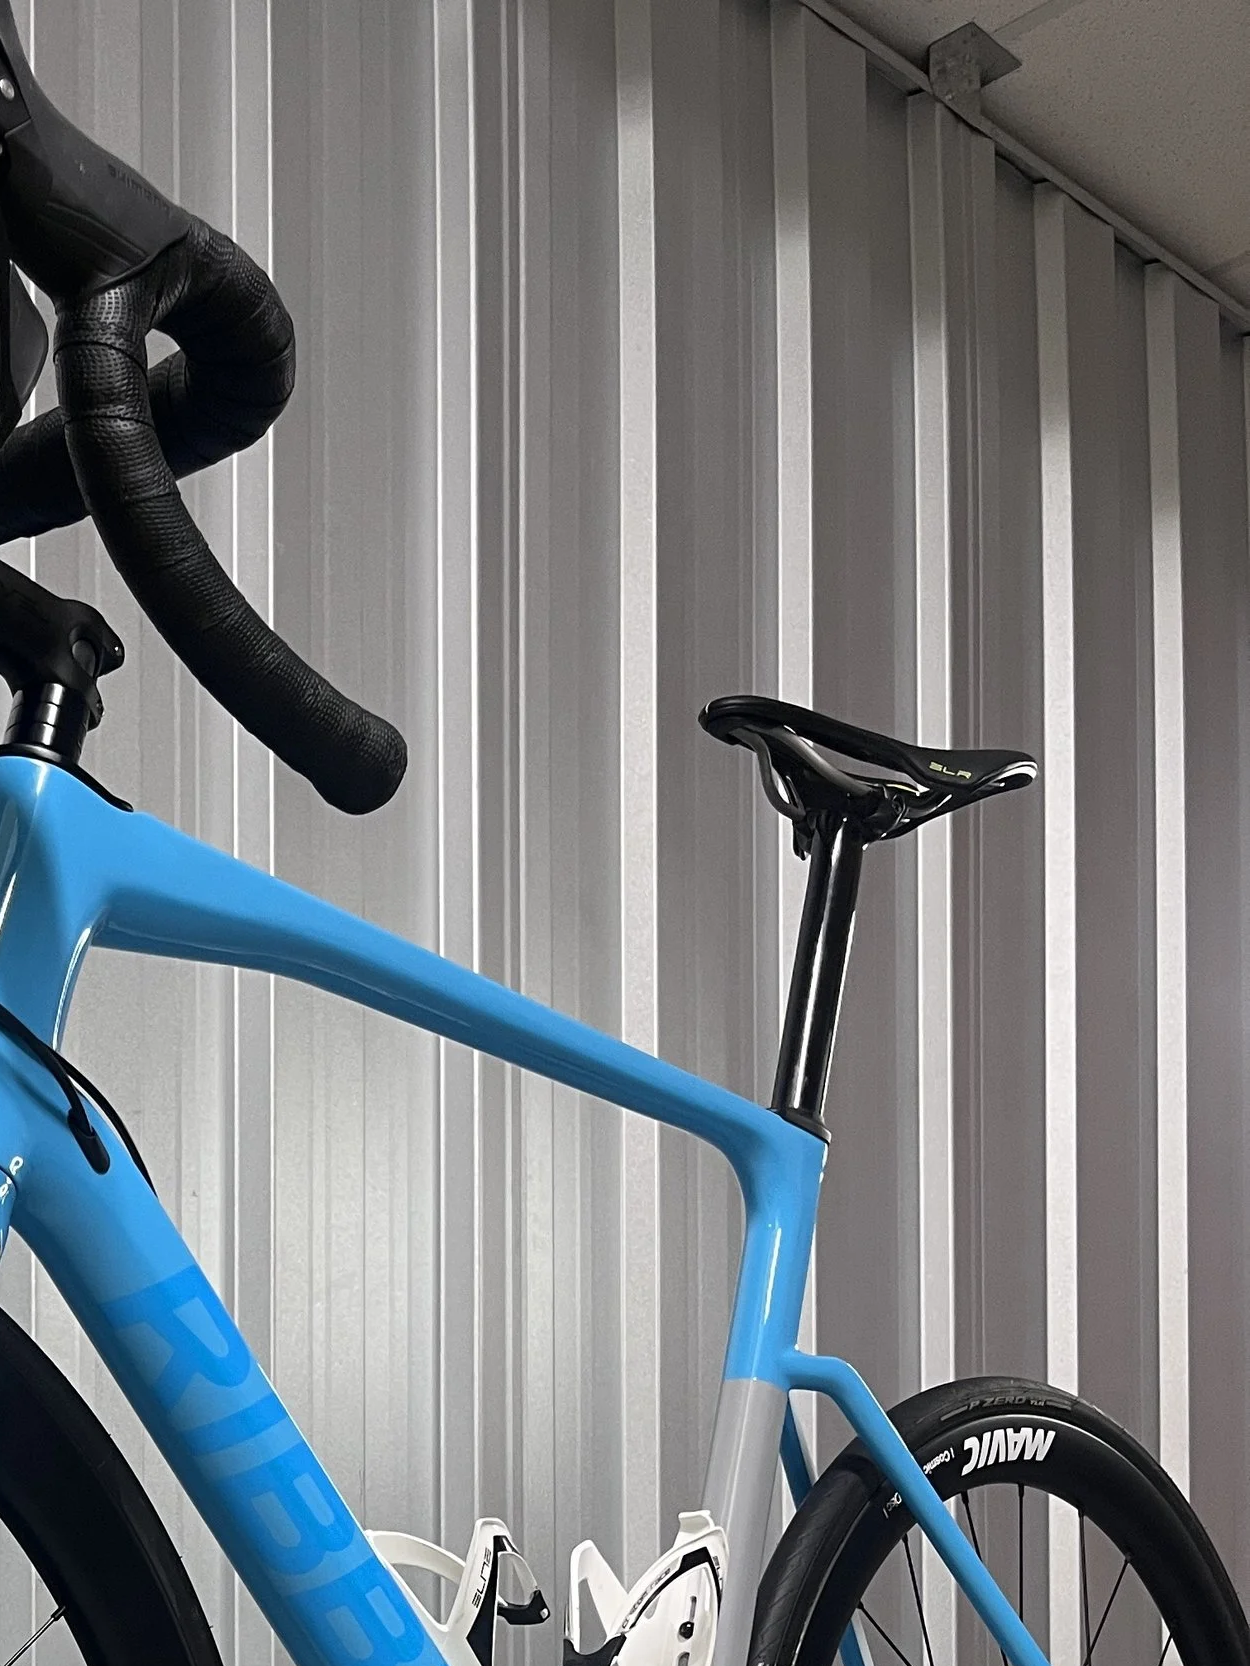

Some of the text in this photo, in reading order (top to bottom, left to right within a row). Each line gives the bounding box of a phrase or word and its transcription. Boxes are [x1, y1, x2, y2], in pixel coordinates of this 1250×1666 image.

[968, 1396, 1026, 1410] P ZERO
[961, 1427, 1056, 1477] MAVIC
